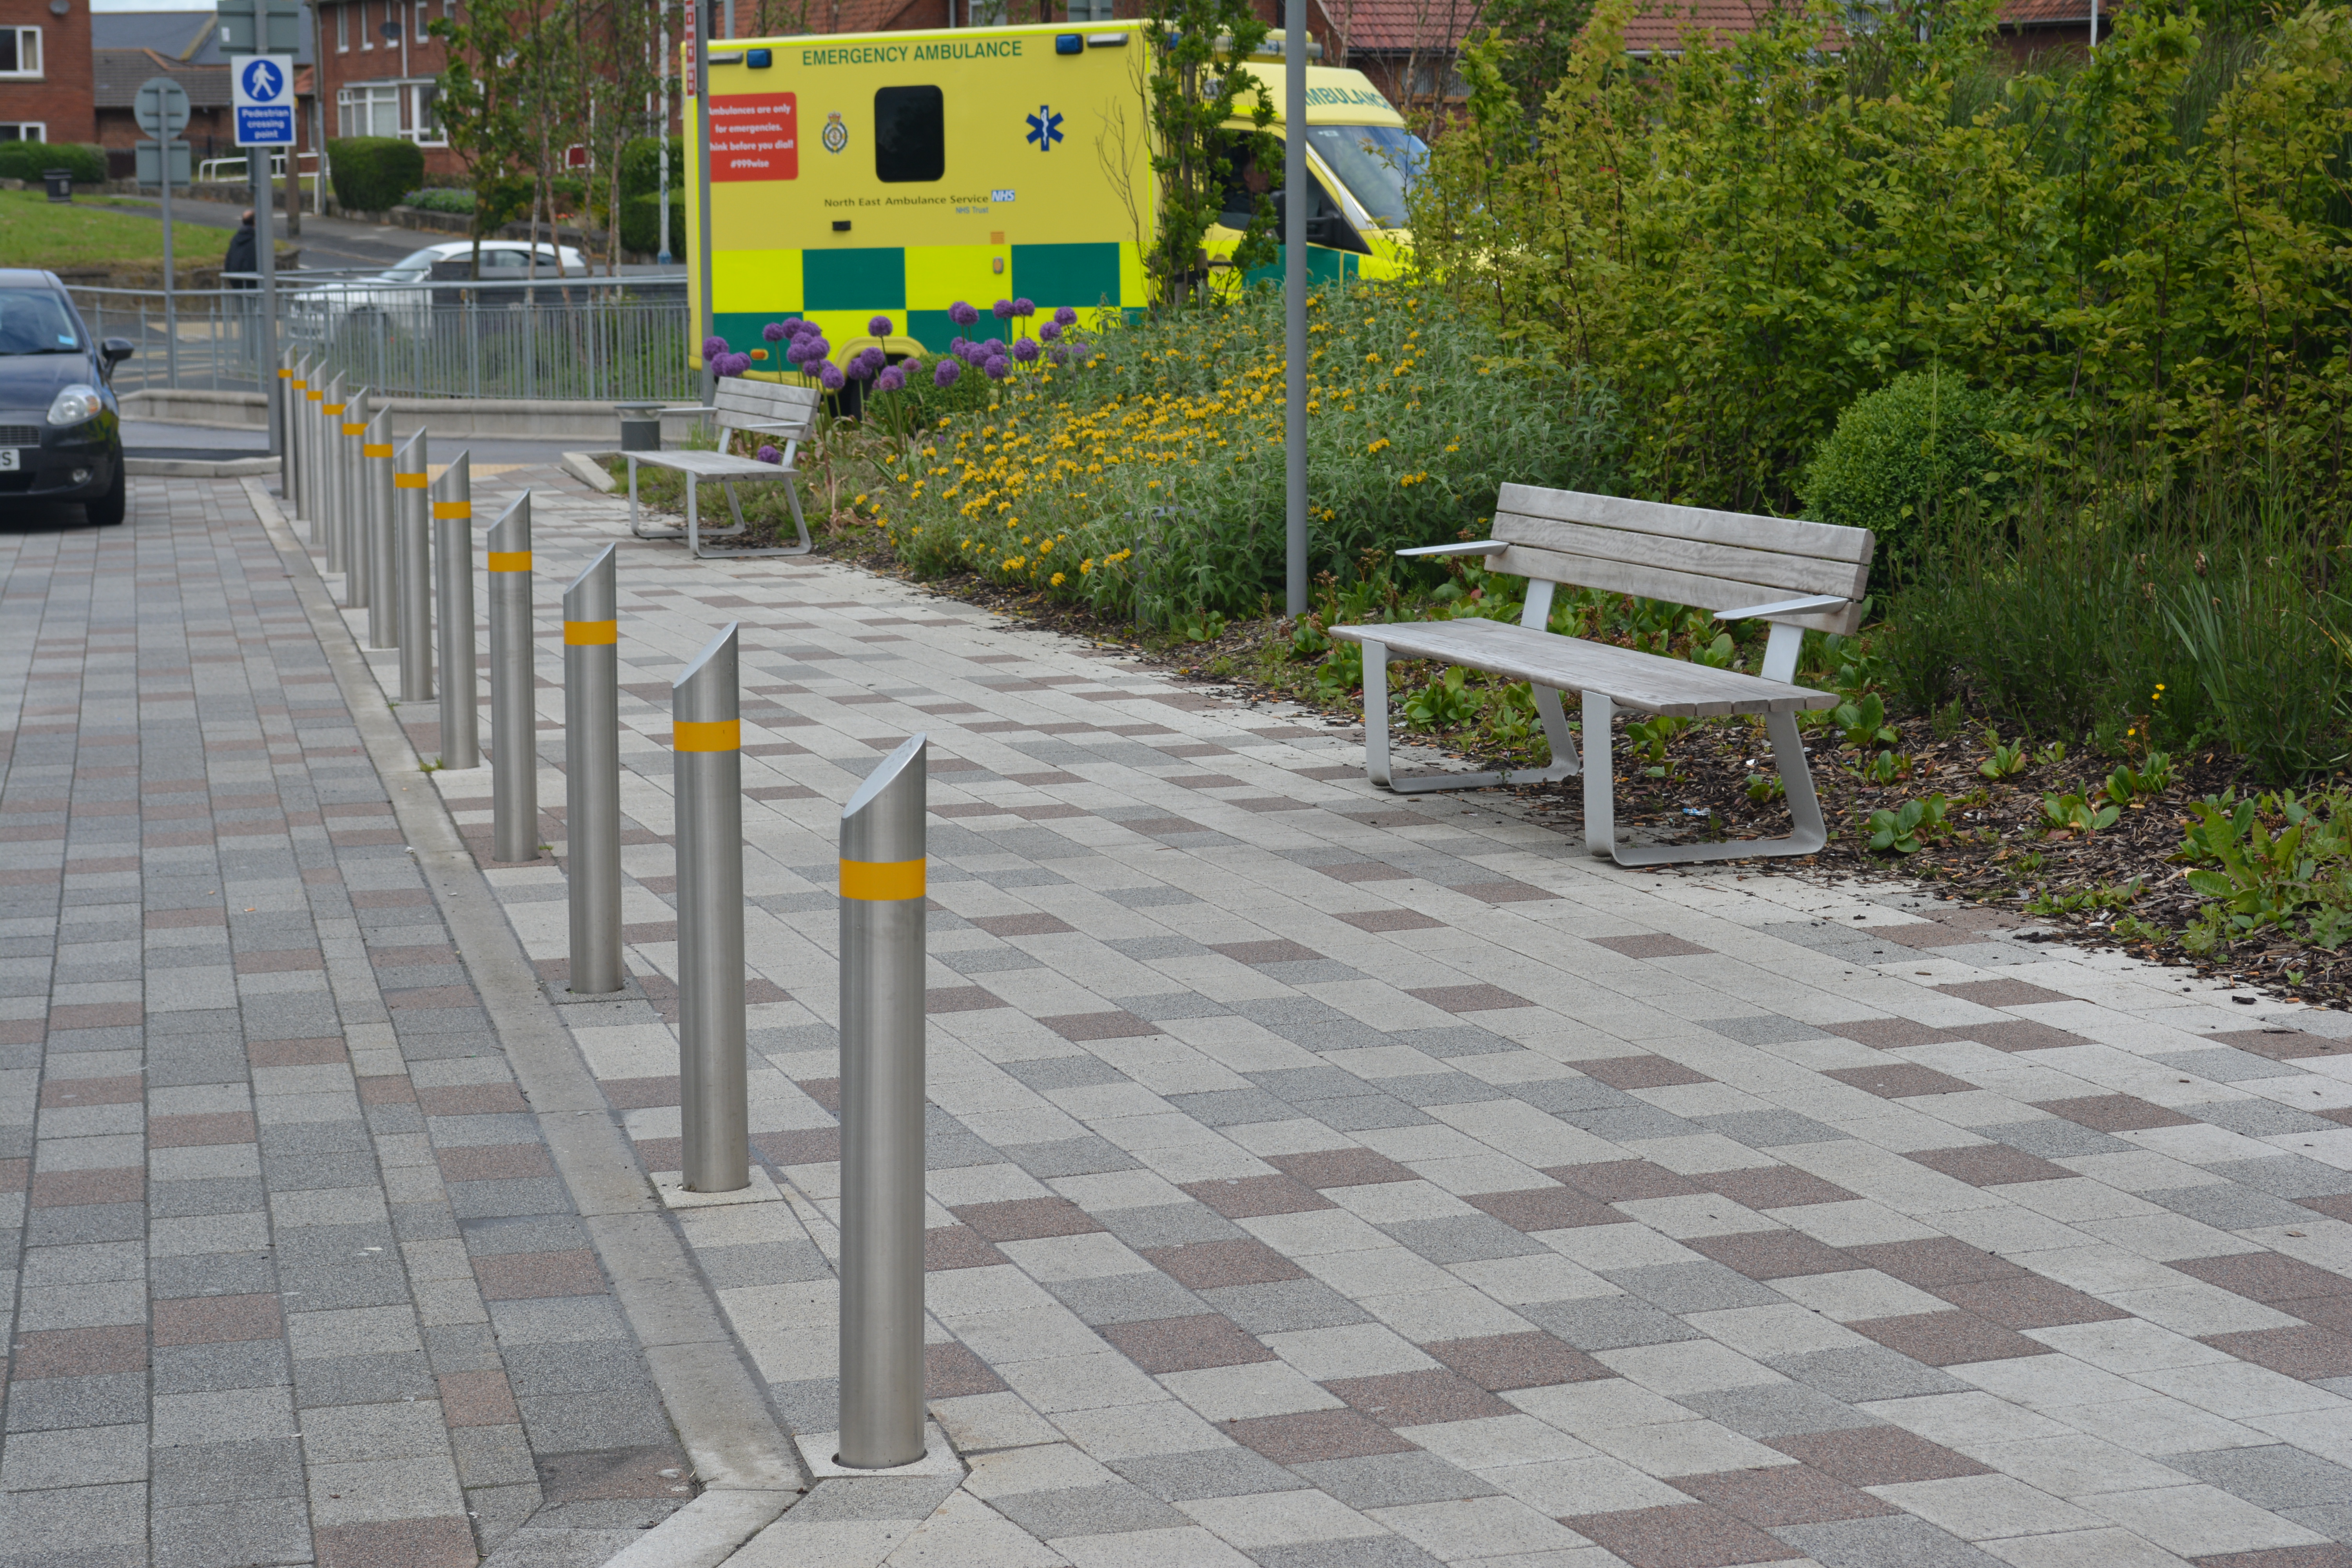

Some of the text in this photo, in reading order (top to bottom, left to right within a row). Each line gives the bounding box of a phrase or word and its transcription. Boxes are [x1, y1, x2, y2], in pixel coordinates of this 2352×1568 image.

[803, 41, 1022, 65] EMERGENCY AMBULANCE
[241, 109, 289, 118] Pedestrian
[773, 103, 791, 114] only
[247, 120, 285, 129] crossing
[715, 122, 782, 134] for emergencies.
[254, 130, 278, 140] point
[710, 142, 728, 151] hink
[730, 141, 756, 151] before
[758, 143, 773, 152] you
[730, 159, 769, 168] #999wise
[824, 198, 855, 207] North
[885, 196, 946, 205] Ambulance
[950, 194, 988, 203] Service
[992, 190, 1014, 201] NHS
[0, 452, 11, 466] S
